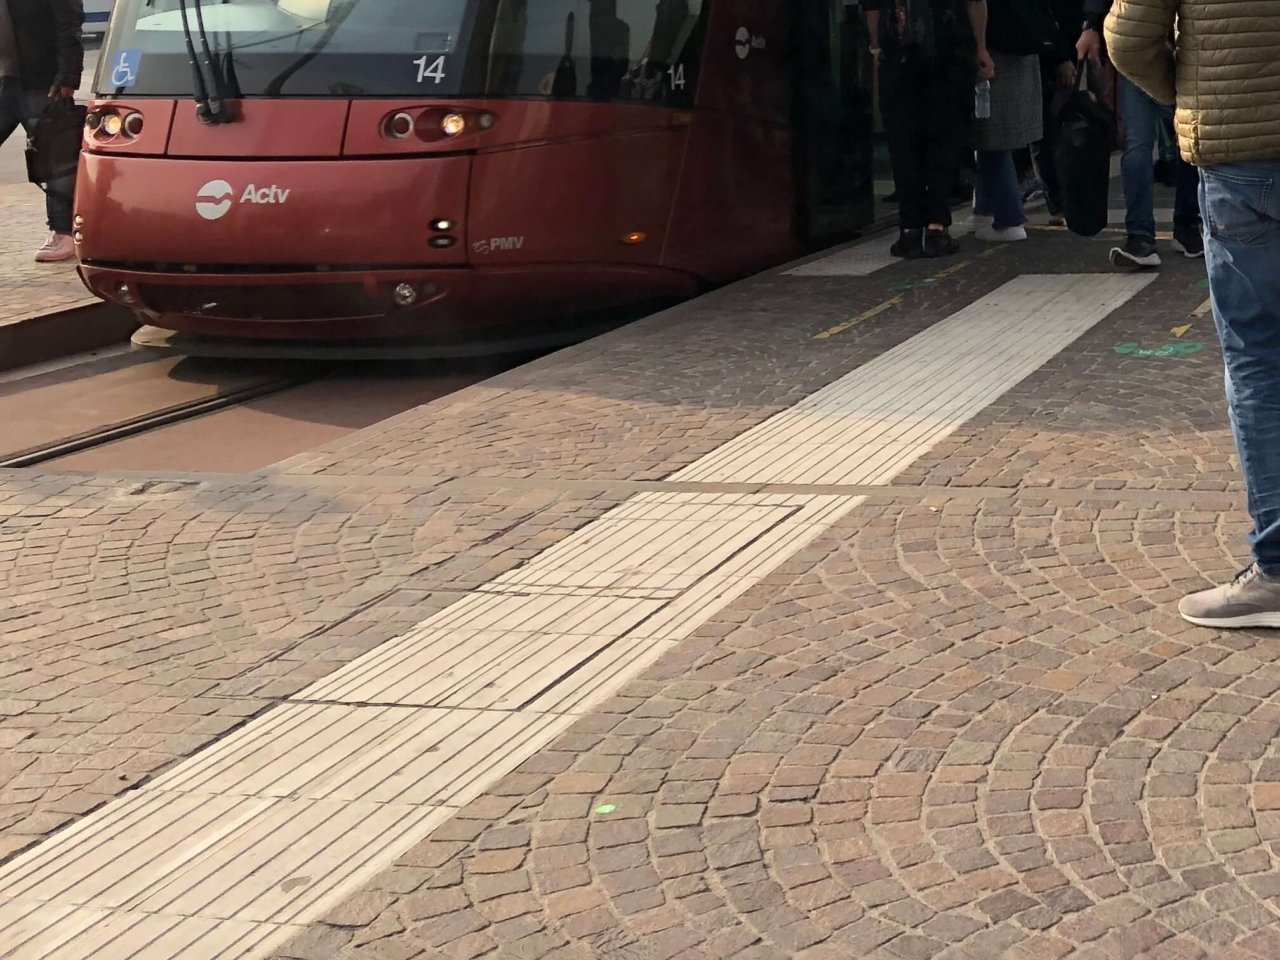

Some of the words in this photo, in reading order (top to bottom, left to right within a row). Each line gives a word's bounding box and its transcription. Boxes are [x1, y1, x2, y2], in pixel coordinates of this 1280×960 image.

[413, 55, 446, 84] 14
[666, 63, 686, 91] 14
[239, 184, 291, 204] Actv
[490, 236, 525, 251] PMV
